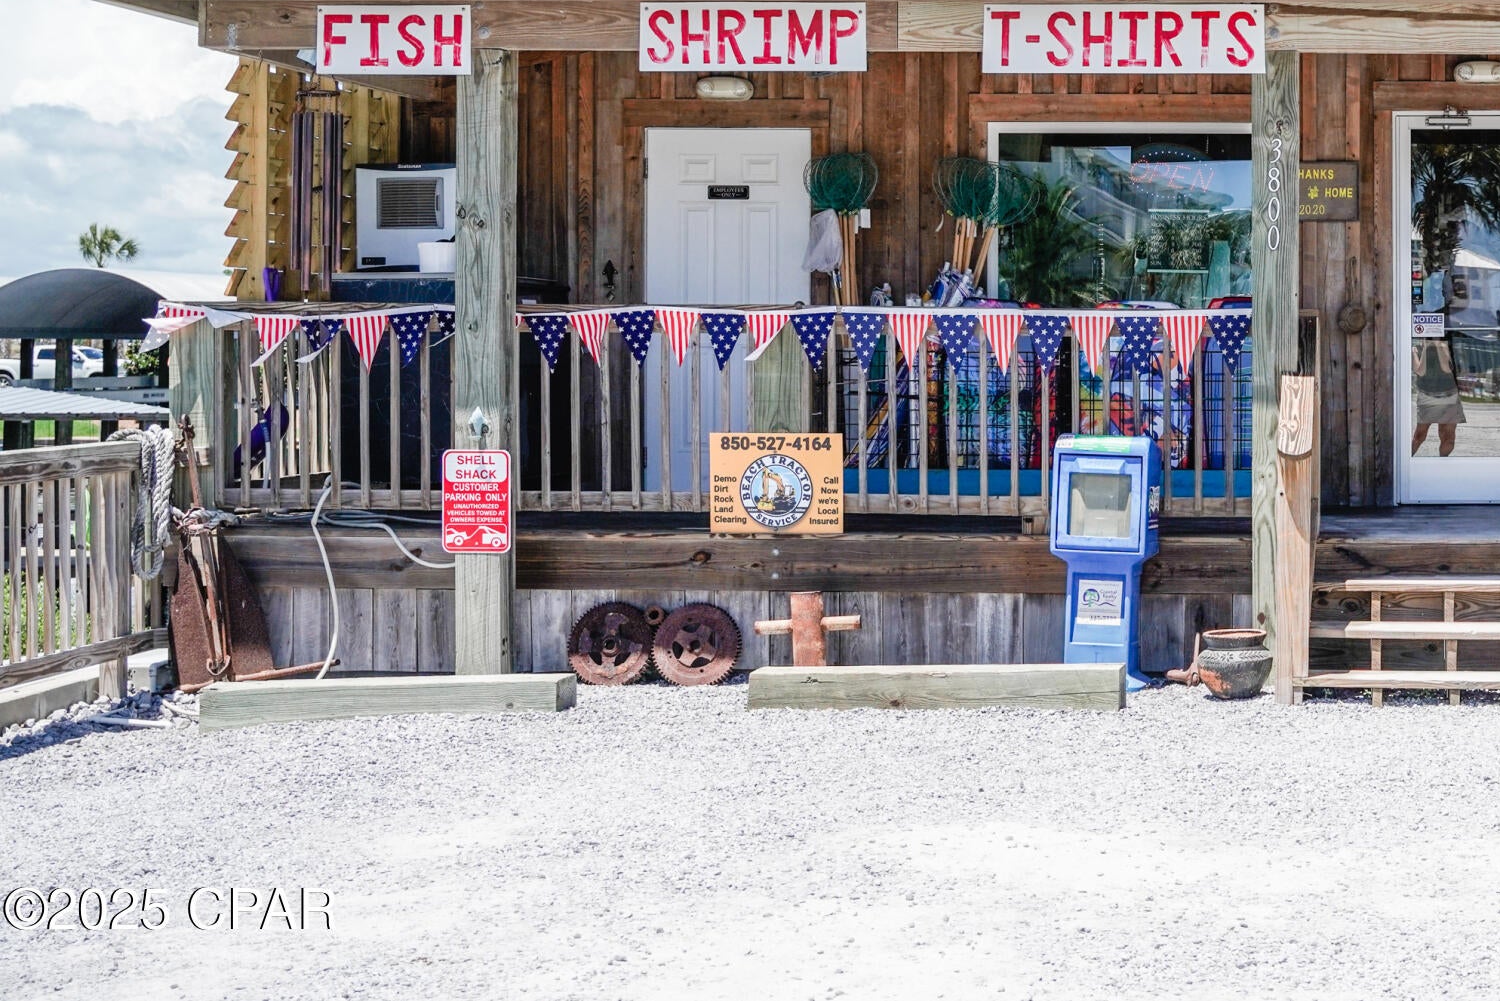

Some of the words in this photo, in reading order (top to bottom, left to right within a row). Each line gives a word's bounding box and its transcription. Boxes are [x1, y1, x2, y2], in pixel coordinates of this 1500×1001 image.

[323, 13, 464, 68] FISH
[646, 8, 859, 65] SHRIMP
[991, 10, 1257, 68] T-SHIRTS
[1129, 158, 1216, 193] OPEN
[1298, 169, 1334, 179] HANKS
[1268, 138, 1282, 251] 3800
[1324, 188, 1353, 198] HOME
[1299, 204, 1325, 215] 2020
[721, 436, 832, 450] 850-527-4164
[457, 455, 495, 465] SHELL
[455, 469, 497, 479] SHACK
[742, 460, 765, 500] BEACH
[770, 456, 811, 502] TRACTOR
[453, 483, 499, 491] CUSTOMER
[445, 493, 481, 501] PARKING
[485, 493, 507, 501] ONLY
[714, 516, 747, 524] Clearing
[756, 513, 798, 526] SERVICE
[809, 517, 839, 525] Insured
